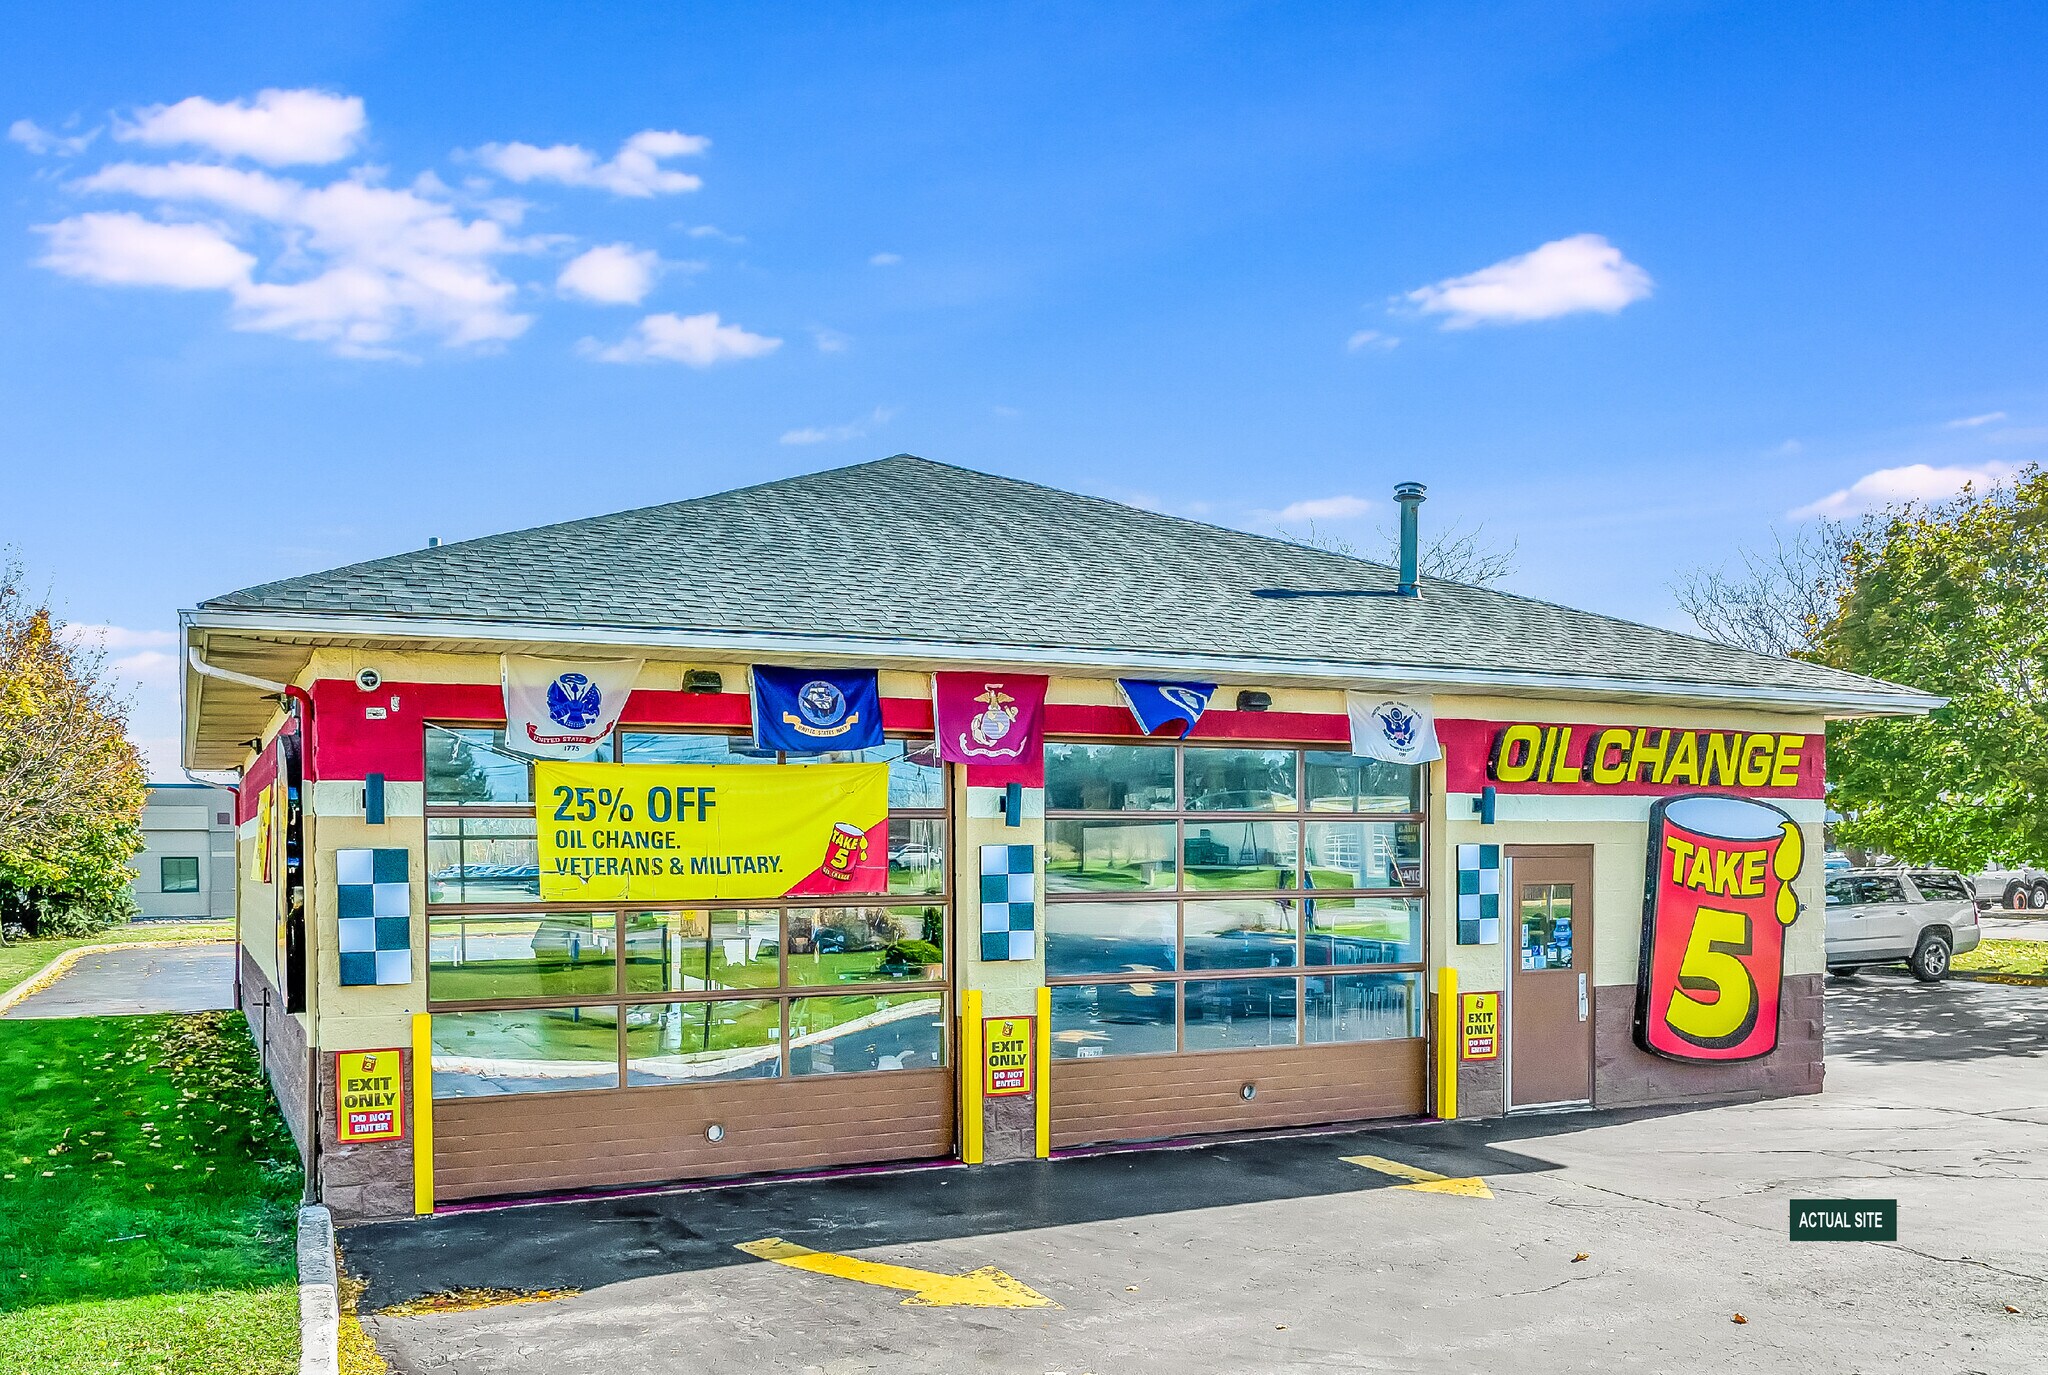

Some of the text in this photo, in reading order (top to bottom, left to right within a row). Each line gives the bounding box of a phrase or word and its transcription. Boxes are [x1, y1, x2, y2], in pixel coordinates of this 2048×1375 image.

[533, 735, 561, 743] UNITED
[1495, 724, 1806, 787] OIL CHANGE
[553, 785, 716, 823] 25% OFF
[555, 829, 681, 850] OIL CHANGE.
[831, 829, 859, 850] TAKE
[555, 855, 783, 876] VETERANS & MILITARY.
[830, 848, 850, 870] 5
[1666, 835, 1769, 897] TAKE
[1664, 906, 1757, 1042] 5
[1468, 1012, 1493, 1023] EXIT
[1465, 1024, 1495, 1035] ONLY
[992, 1040, 1024, 1053] EXIT
[989, 1054, 1027, 1067] ONLY
[1007, 1070, 1023, 1078] NOT
[347, 1077, 392, 1092] EXIT
[995, 1079, 1021, 1087] ENTER
[344, 1092, 396, 1108] ONLY
[350, 1113, 392, 1122] DO NOT
[354, 1122, 389, 1133] ENTER
